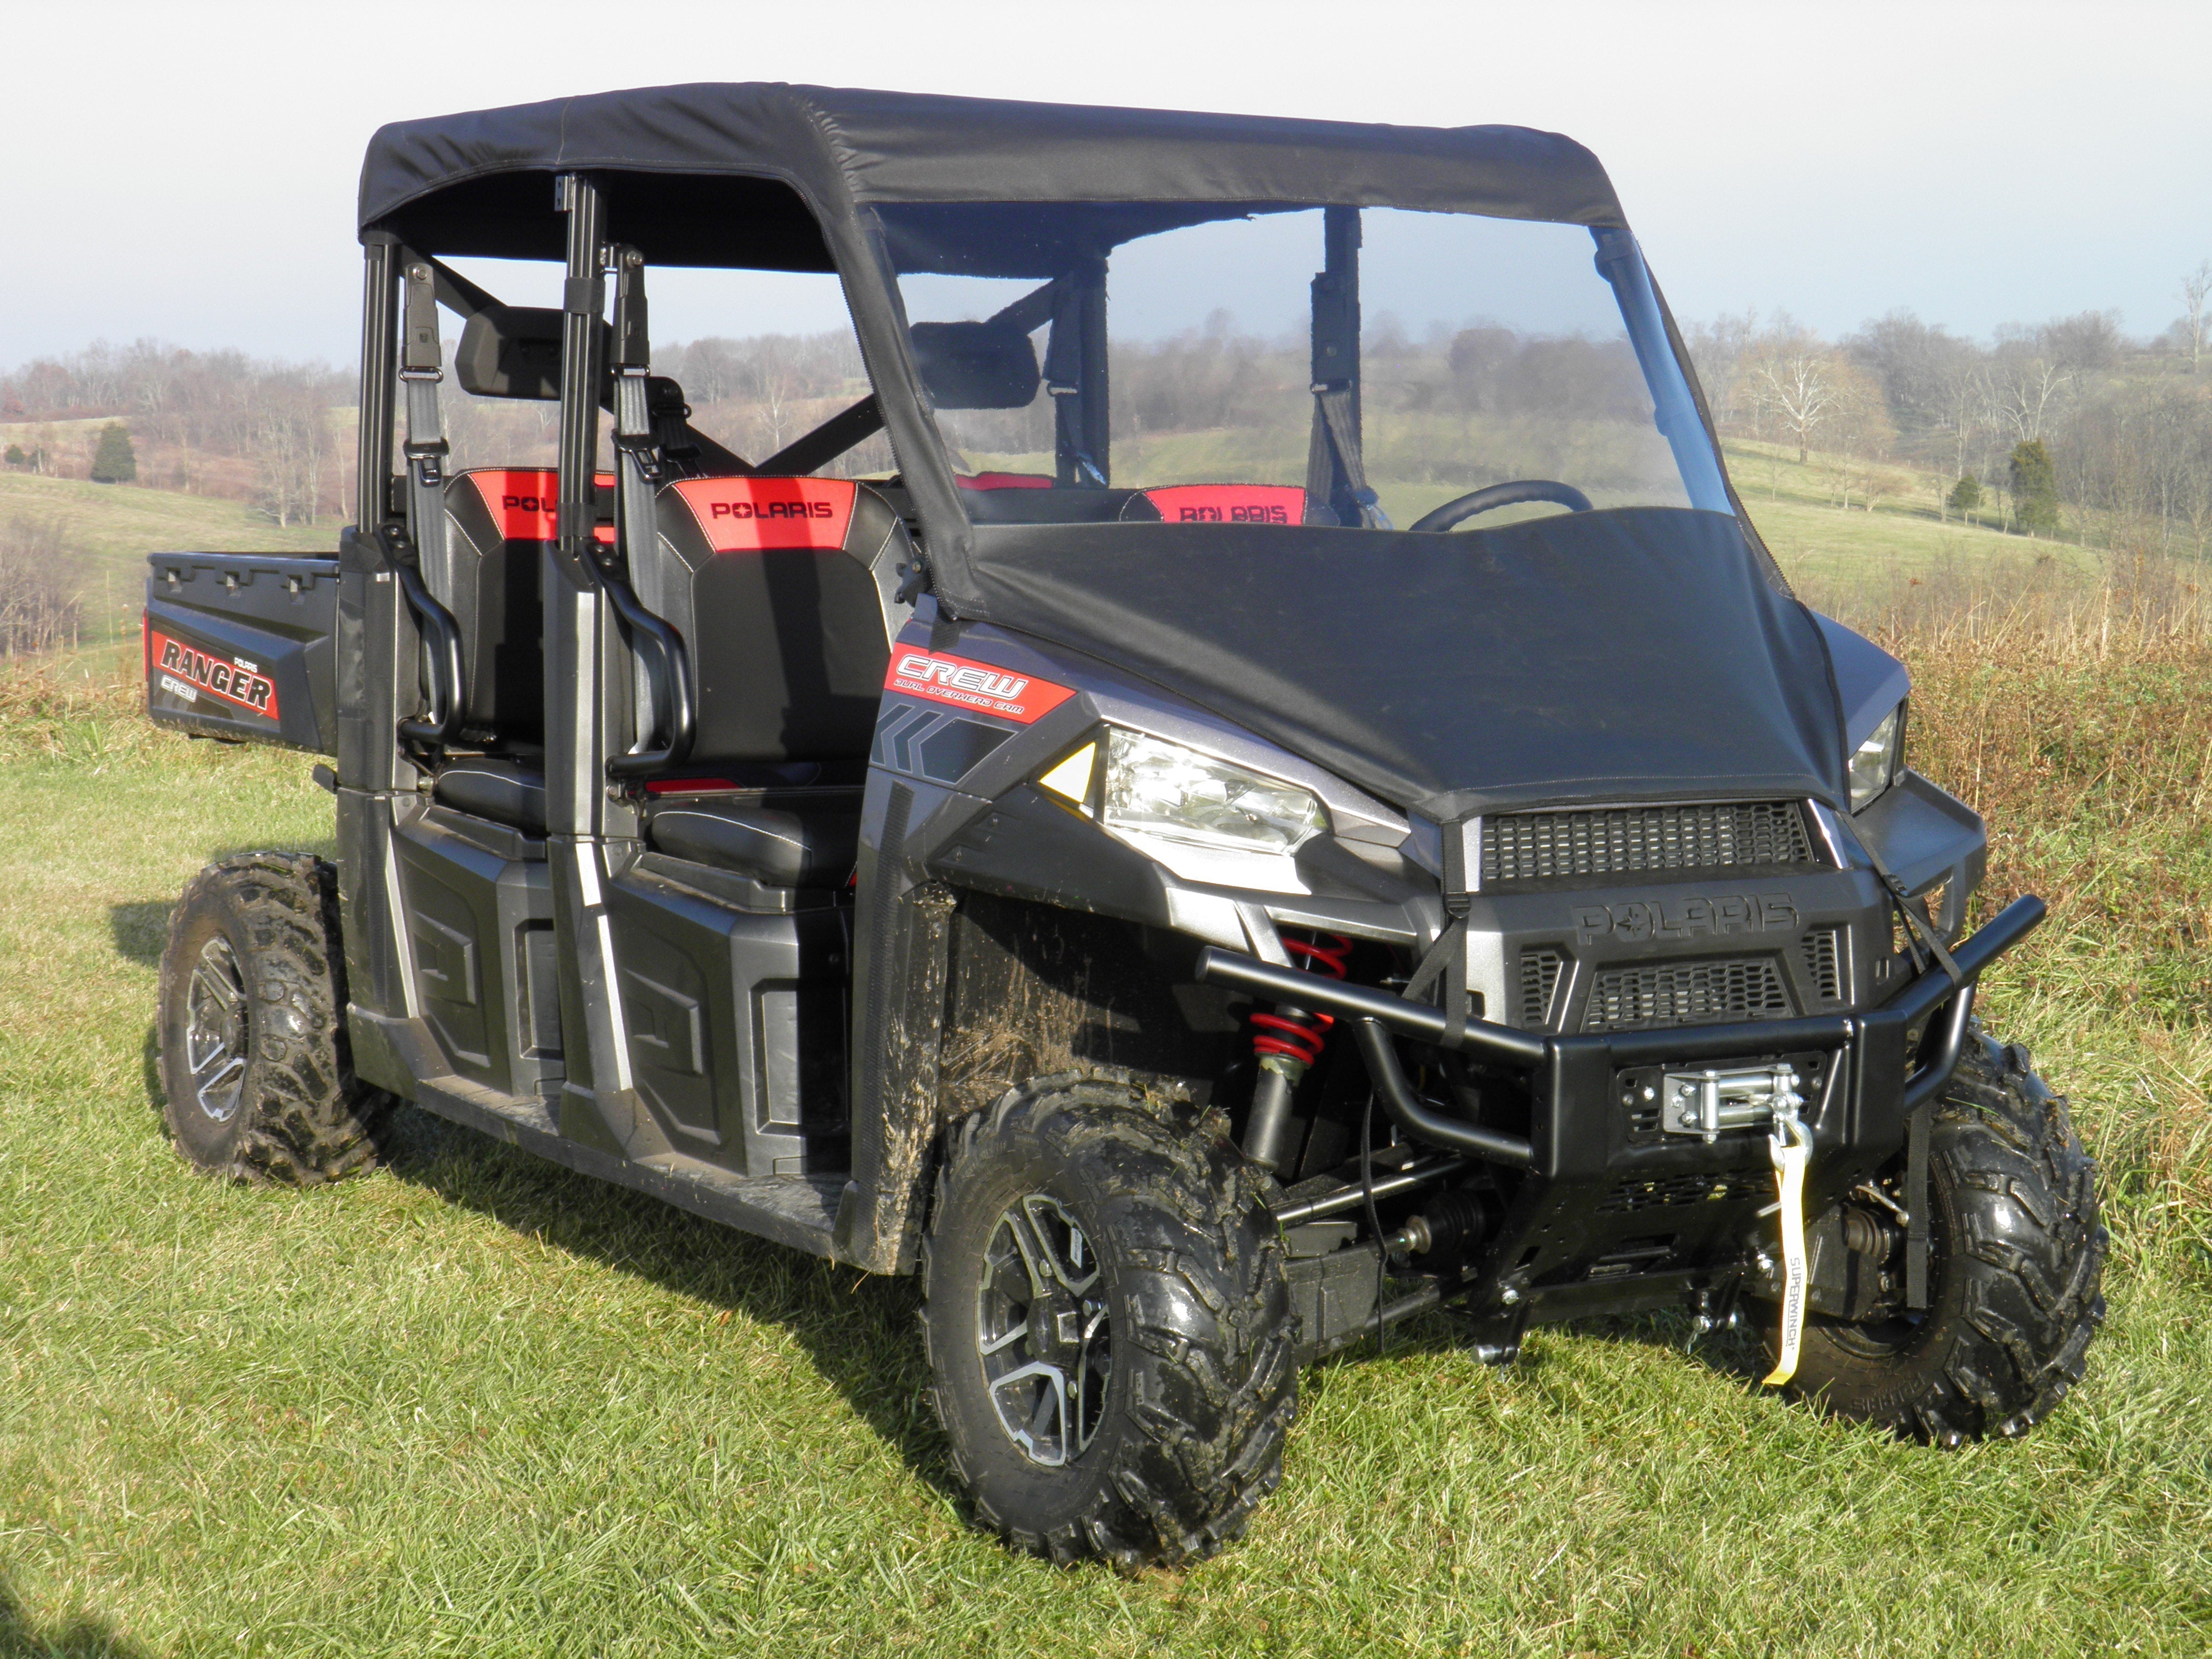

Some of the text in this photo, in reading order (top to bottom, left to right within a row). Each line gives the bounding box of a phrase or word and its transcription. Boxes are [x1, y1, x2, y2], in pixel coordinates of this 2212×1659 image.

[710, 501, 833, 519] POLARIS
[160, 639, 272, 711] RANGER
[234, 657, 257, 673] POLARIS
[897, 654, 1029, 701] CREW
[161, 675, 198, 703] CREW
[893, 679, 1024, 715] DUAL OVERHEAD CAM
[1571, 892, 1799, 946] POLARIS
[1786, 1257, 1801, 1348] SUPERWINCH
